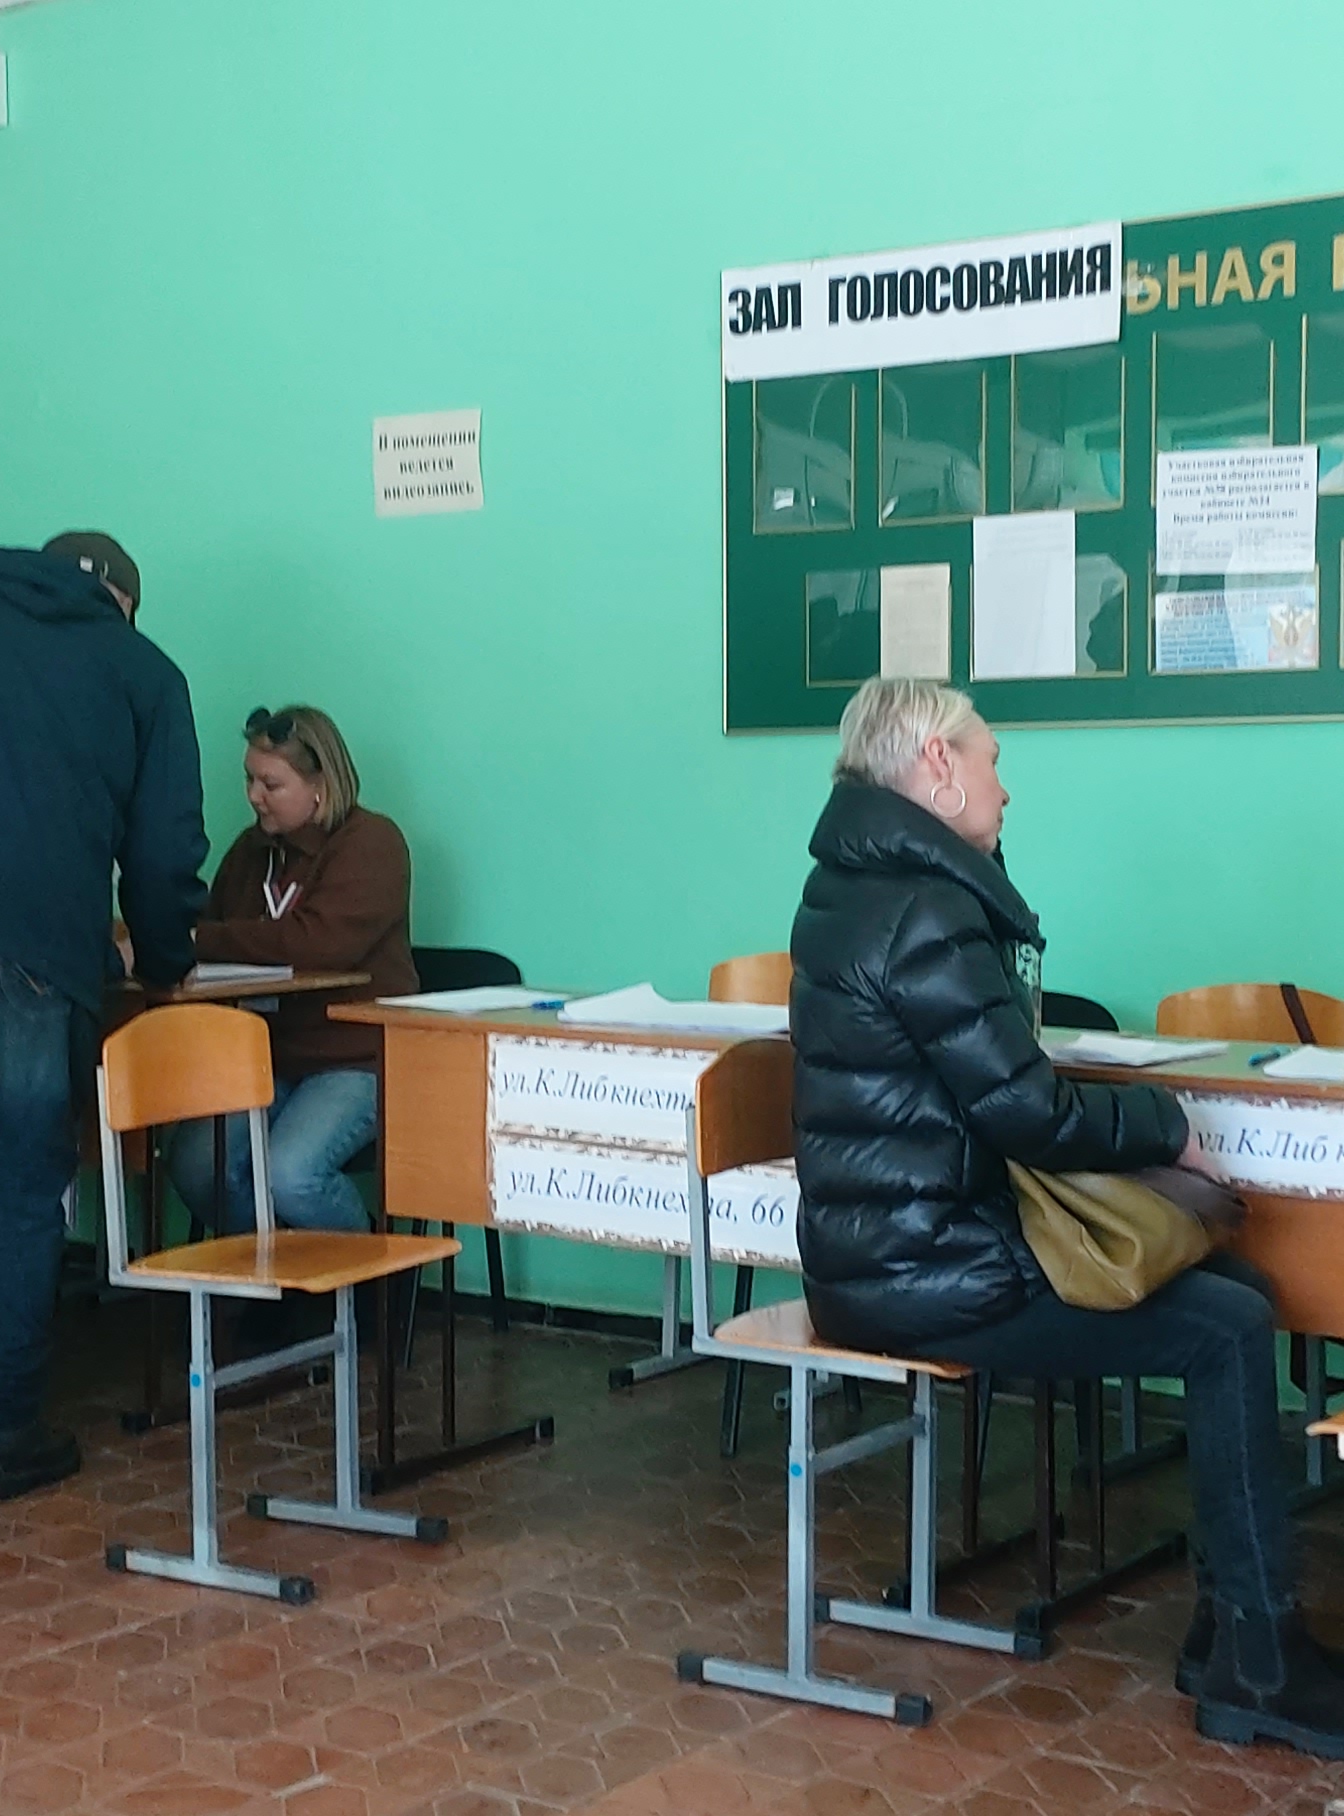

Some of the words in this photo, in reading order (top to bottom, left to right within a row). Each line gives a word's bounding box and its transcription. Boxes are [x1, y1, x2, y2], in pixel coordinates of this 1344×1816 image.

[728, 279, 802, 335] ЗАЛ
[827, 242, 1112, 327] ГОЛОСОВАНИЯ
[393, 430, 476, 452] помещении
[399, 456, 454, 475] ведется
[1229, 453, 1304, 470] избирательная
[1221, 468, 1301, 482] избирательного
[507, 1165, 739, 1225] ул.К.Либкнеха,
